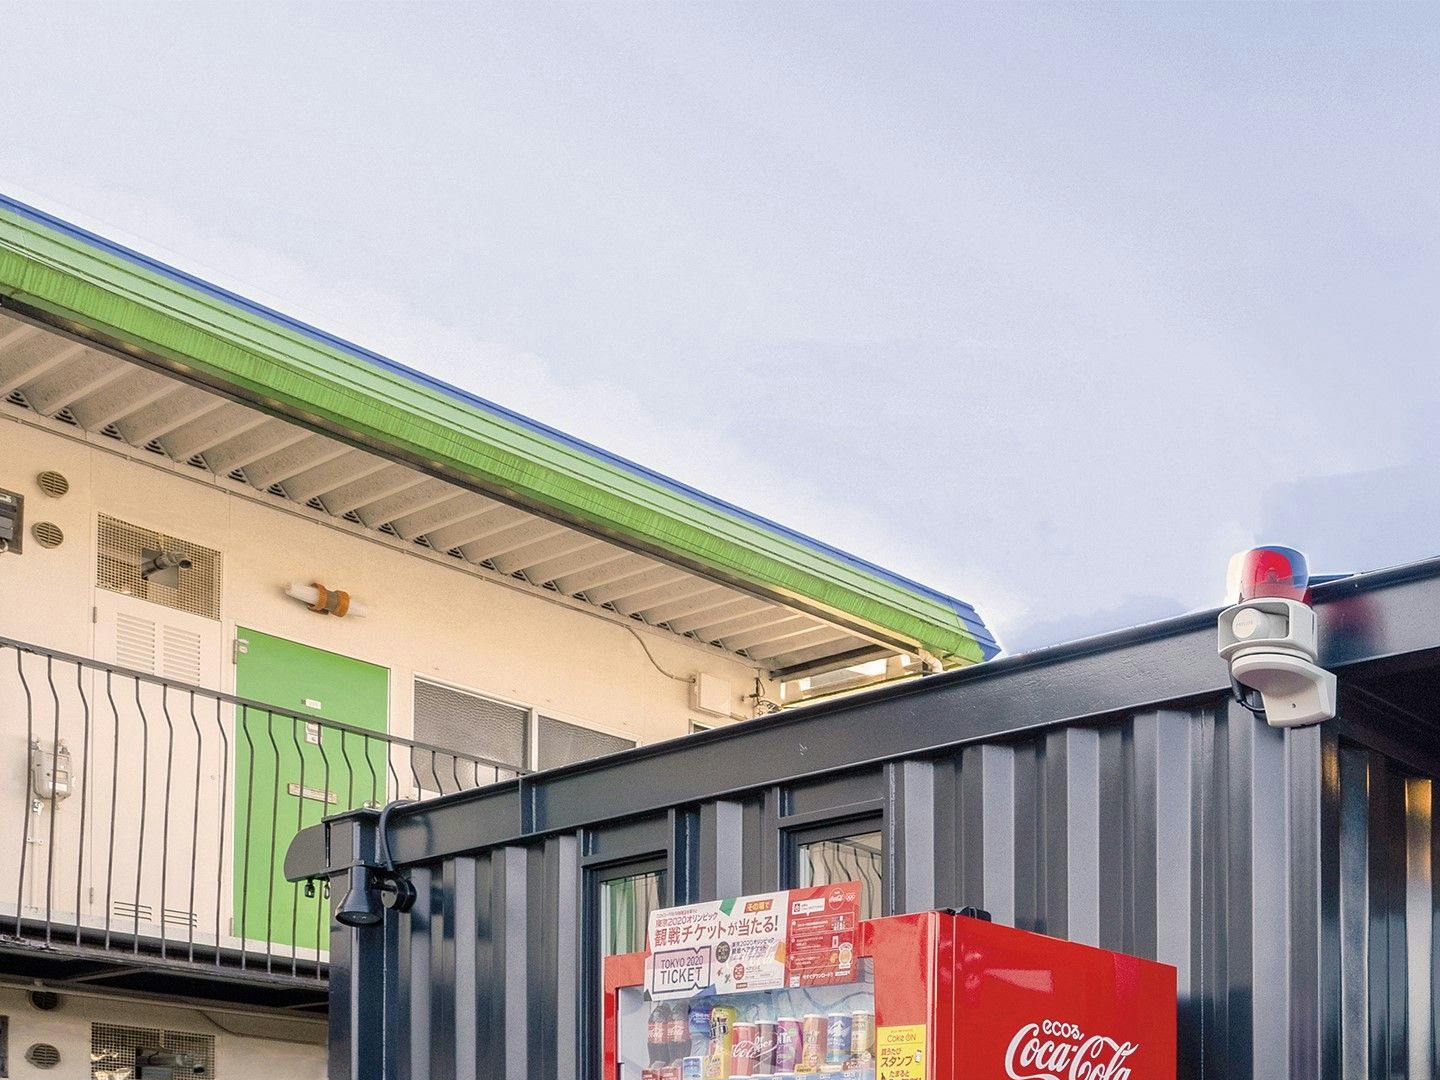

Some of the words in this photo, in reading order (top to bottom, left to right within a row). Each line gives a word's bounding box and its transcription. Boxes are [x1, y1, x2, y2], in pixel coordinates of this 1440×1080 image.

[655, 912, 719, 927] 東京2020オリンピック
[655, 915, 779, 947] 観戦チケットが当たる!
[660, 958, 685, 969] TOKYO
[686, 955, 704, 967] 2020
[660, 966, 703, 985] TICKET
[887, 1034, 905, 1043] Coke
[905, 1033, 917, 1041] ON
[880, 1055, 914, 1068] スタンプ
